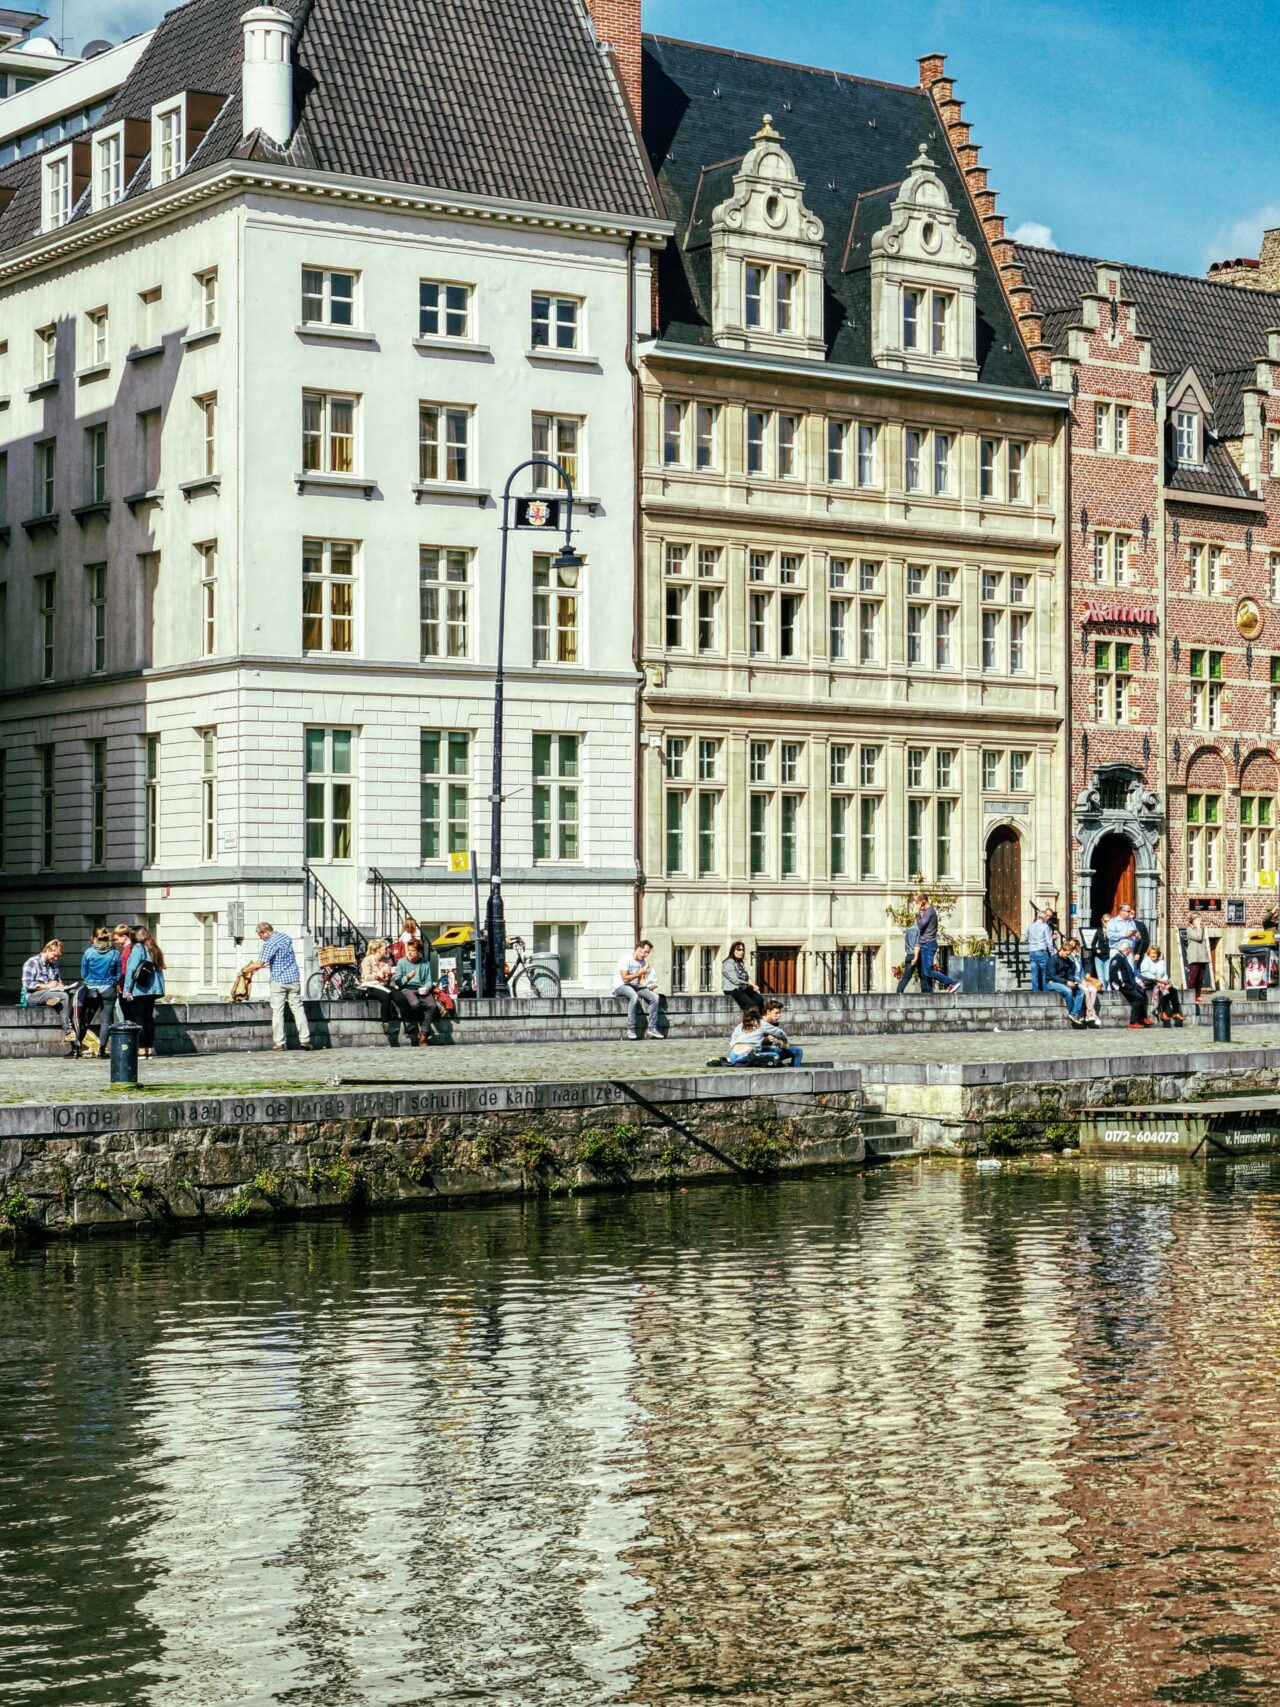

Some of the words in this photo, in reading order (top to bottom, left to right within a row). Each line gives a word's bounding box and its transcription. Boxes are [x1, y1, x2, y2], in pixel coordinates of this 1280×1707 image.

[479, 1089, 498, 1106] de
[596, 1086, 621, 1100] zee
[1105, 1130, 1179, 1144] 0172-604073
[1234, 1131, 1271, 1144] Hameren
